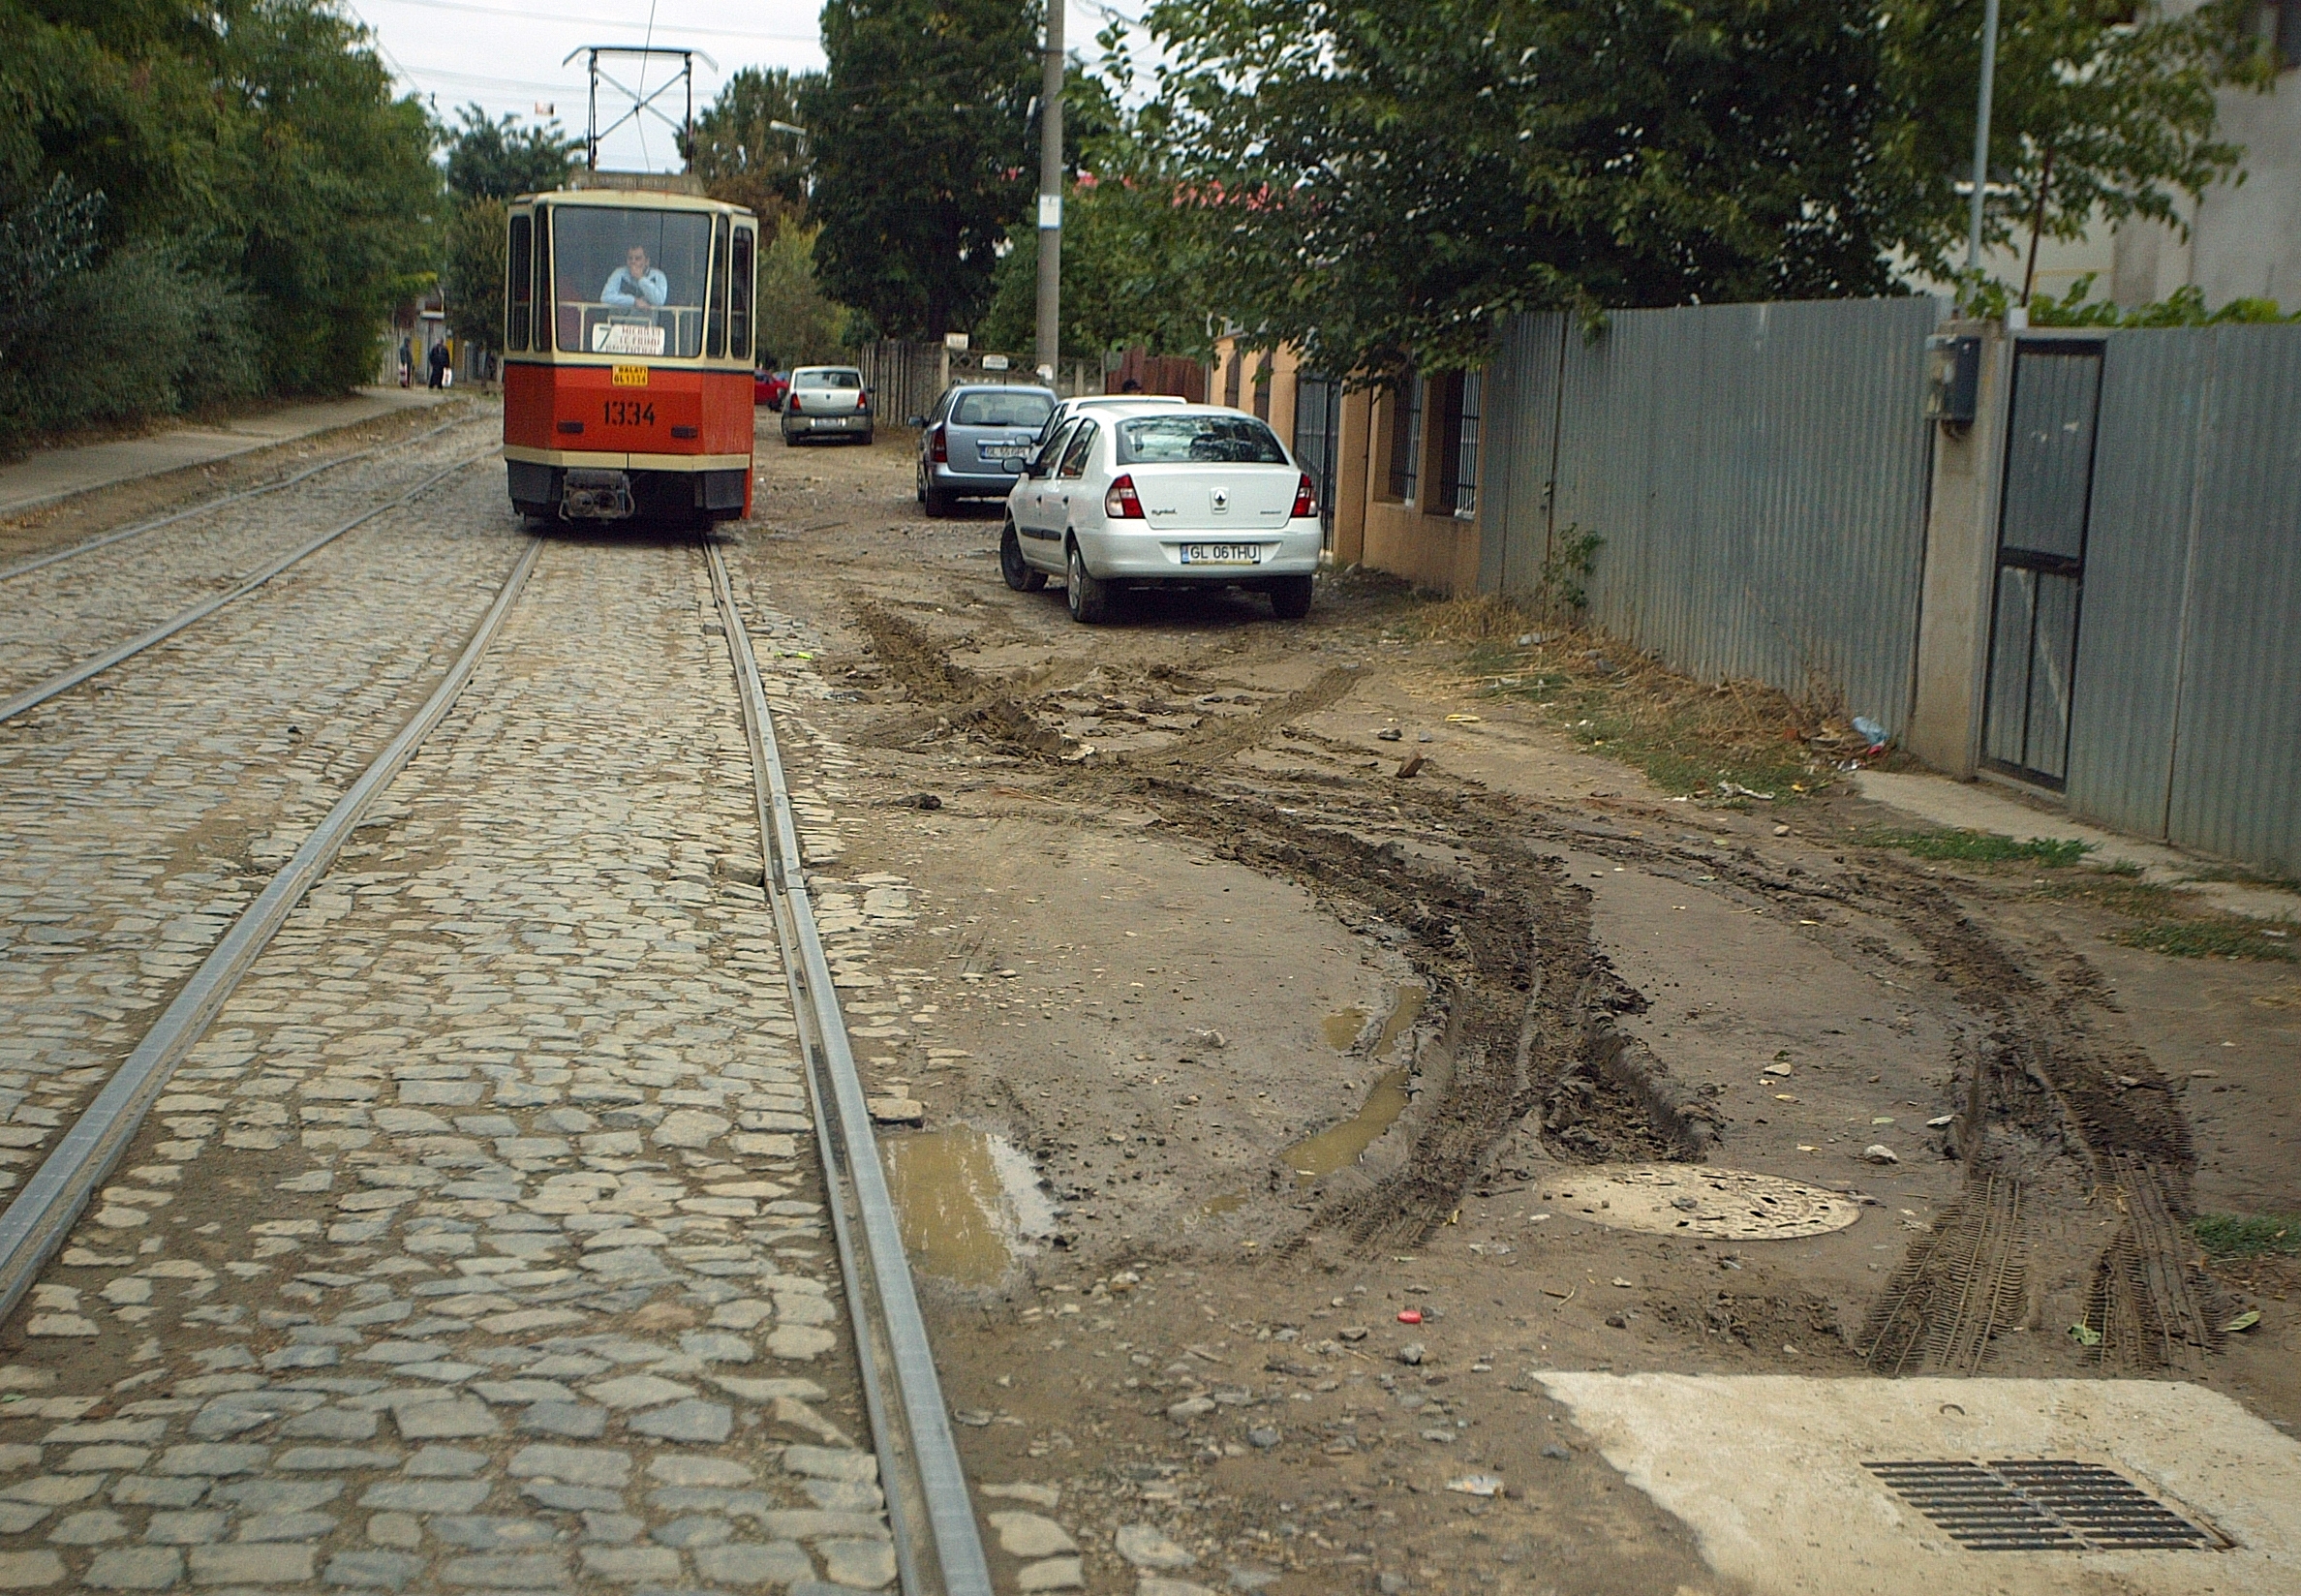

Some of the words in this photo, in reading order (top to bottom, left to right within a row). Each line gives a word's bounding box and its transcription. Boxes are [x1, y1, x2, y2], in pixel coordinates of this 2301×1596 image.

[598, 325, 612, 351] 7
[604, 400, 656, 426] 1334
[1190, 545, 1209, 559] GL
